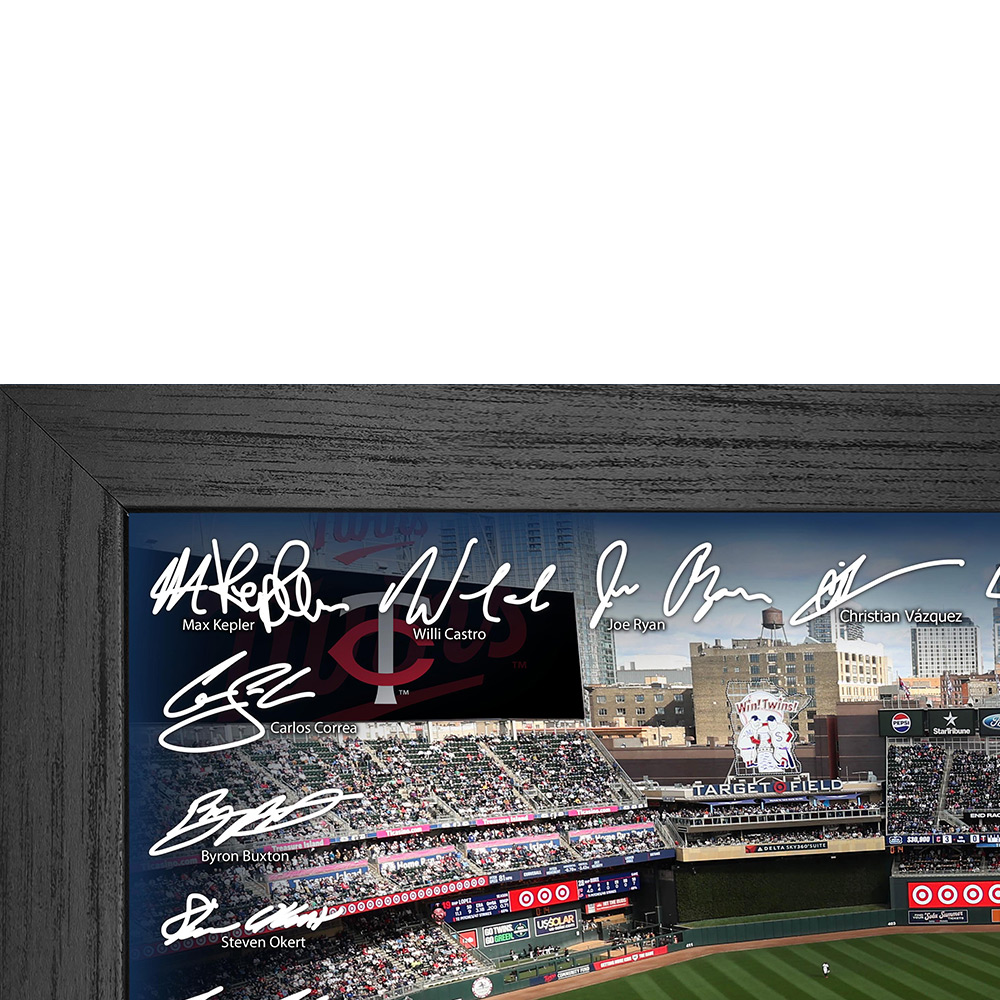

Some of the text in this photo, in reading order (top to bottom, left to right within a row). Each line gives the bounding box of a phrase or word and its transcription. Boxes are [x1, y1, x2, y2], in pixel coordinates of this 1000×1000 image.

[735, 697, 799, 714] Win! Twins!
[695, 780, 843, 796] TARGET FIELD
[763, 843, 785, 852] DELTA
[484, 928, 494, 936] GO
[485, 935, 495, 944] GO
